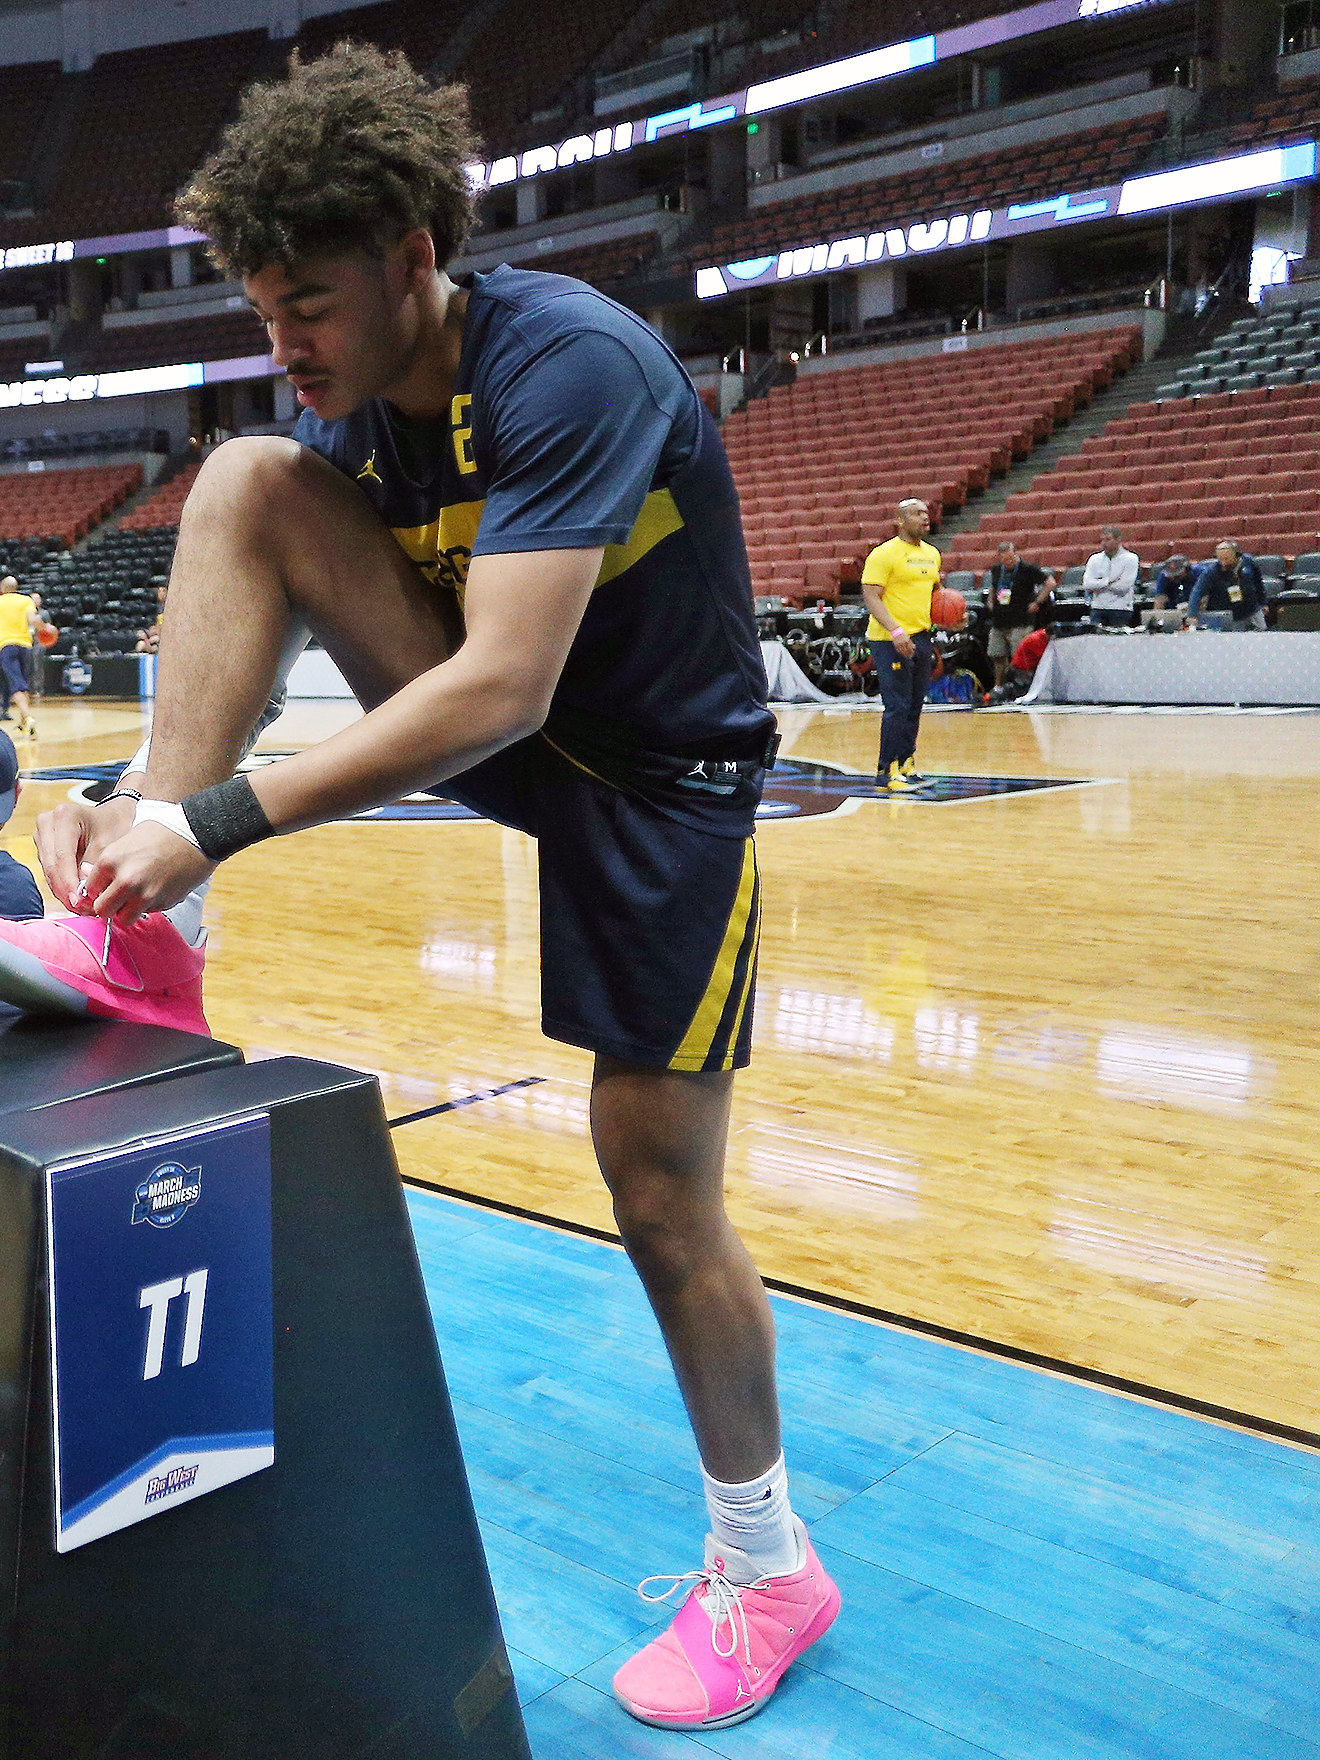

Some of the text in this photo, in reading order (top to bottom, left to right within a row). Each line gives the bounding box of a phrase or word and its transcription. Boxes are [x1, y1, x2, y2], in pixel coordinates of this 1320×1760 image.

[147, 1175, 184, 1199] MARCH
[152, 1184, 199, 1211] MADNESS
[139, 1268, 209, 1382] T1
